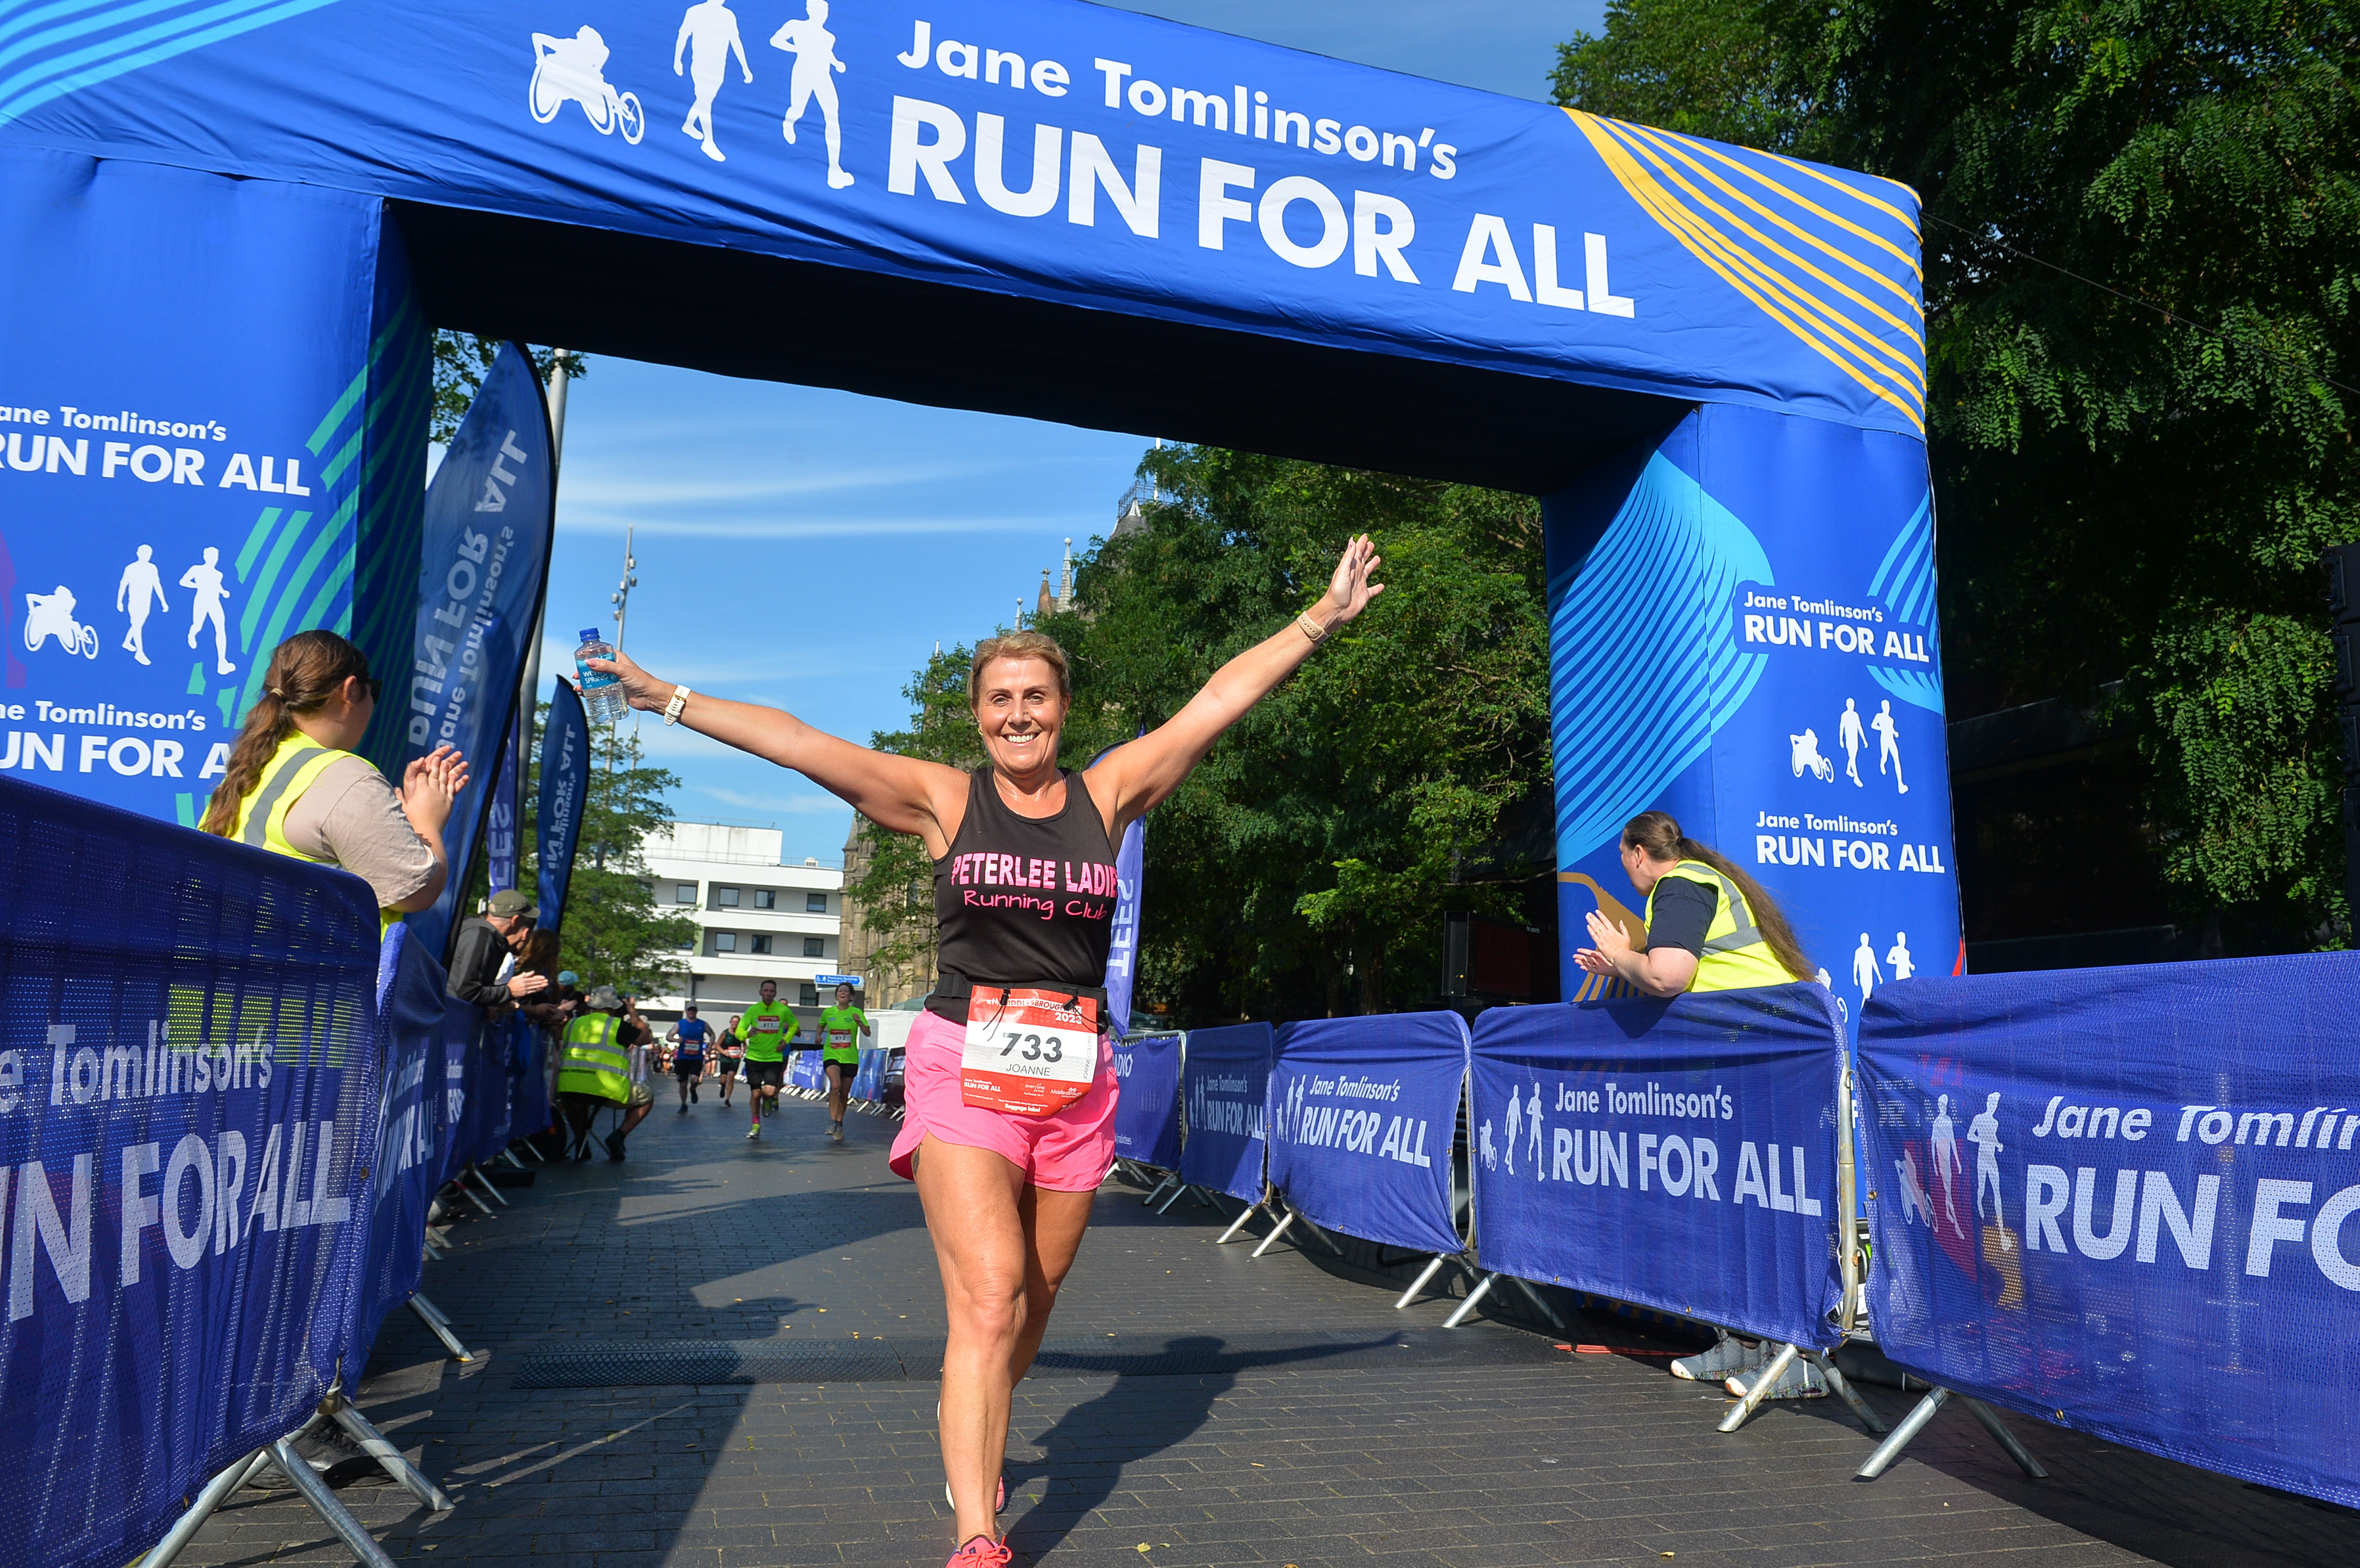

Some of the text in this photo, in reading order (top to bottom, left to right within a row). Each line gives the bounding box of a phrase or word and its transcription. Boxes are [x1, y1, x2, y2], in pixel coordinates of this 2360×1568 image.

[896, 19, 1458, 181] Jane Tomlinson's
[887, 95, 1635, 319] RUN FOR ALL
[59, 406, 227, 441] Tomlinson's
[102, 442, 204, 486] FOR
[219, 453, 310, 497] ALL
[1744, 591, 1883, 622] Jane Tomlinson's
[1744, 614, 1930, 663] RUN FOR ALL
[35, 700, 206, 731] Tomlinson's
[79, 735, 184, 778] FOR
[1755, 810, 1898, 836] Jane Tomlinson's
[1756, 835, 1946, 874] RUN FOR ALL
[951, 852, 1117, 898] PETERLEE LADIE
[964, 890, 1107, 920] Running Club
[1055, 1012, 1082, 1025] 2023
[47, 1020, 273, 1106] Tomlinson's
[1000, 1032, 1062, 1062] 733
[1006, 1064, 1051, 1076] JOANNE
[1207, 1075, 1218, 1092] Jane
[1310, 1074, 1400, 1102] Jane Tomlinson's
[1005, 1103, 1027, 1112] Baggage
[1207, 1100, 1264, 1141] RUN FOR ALL
[1555, 1082, 1732, 1120] Jane Tomlinson's
[2033, 1096, 2152, 1140] Jane
[1299, 1106, 1430, 1168] RUN FOR ALL
[1552, 1127, 1821, 1217] RUN FOR ALL
[121, 1131, 246, 1287] FOR
[243, 1120, 350, 1237] ALL
[2025, 1165, 2220, 1270] RUN
